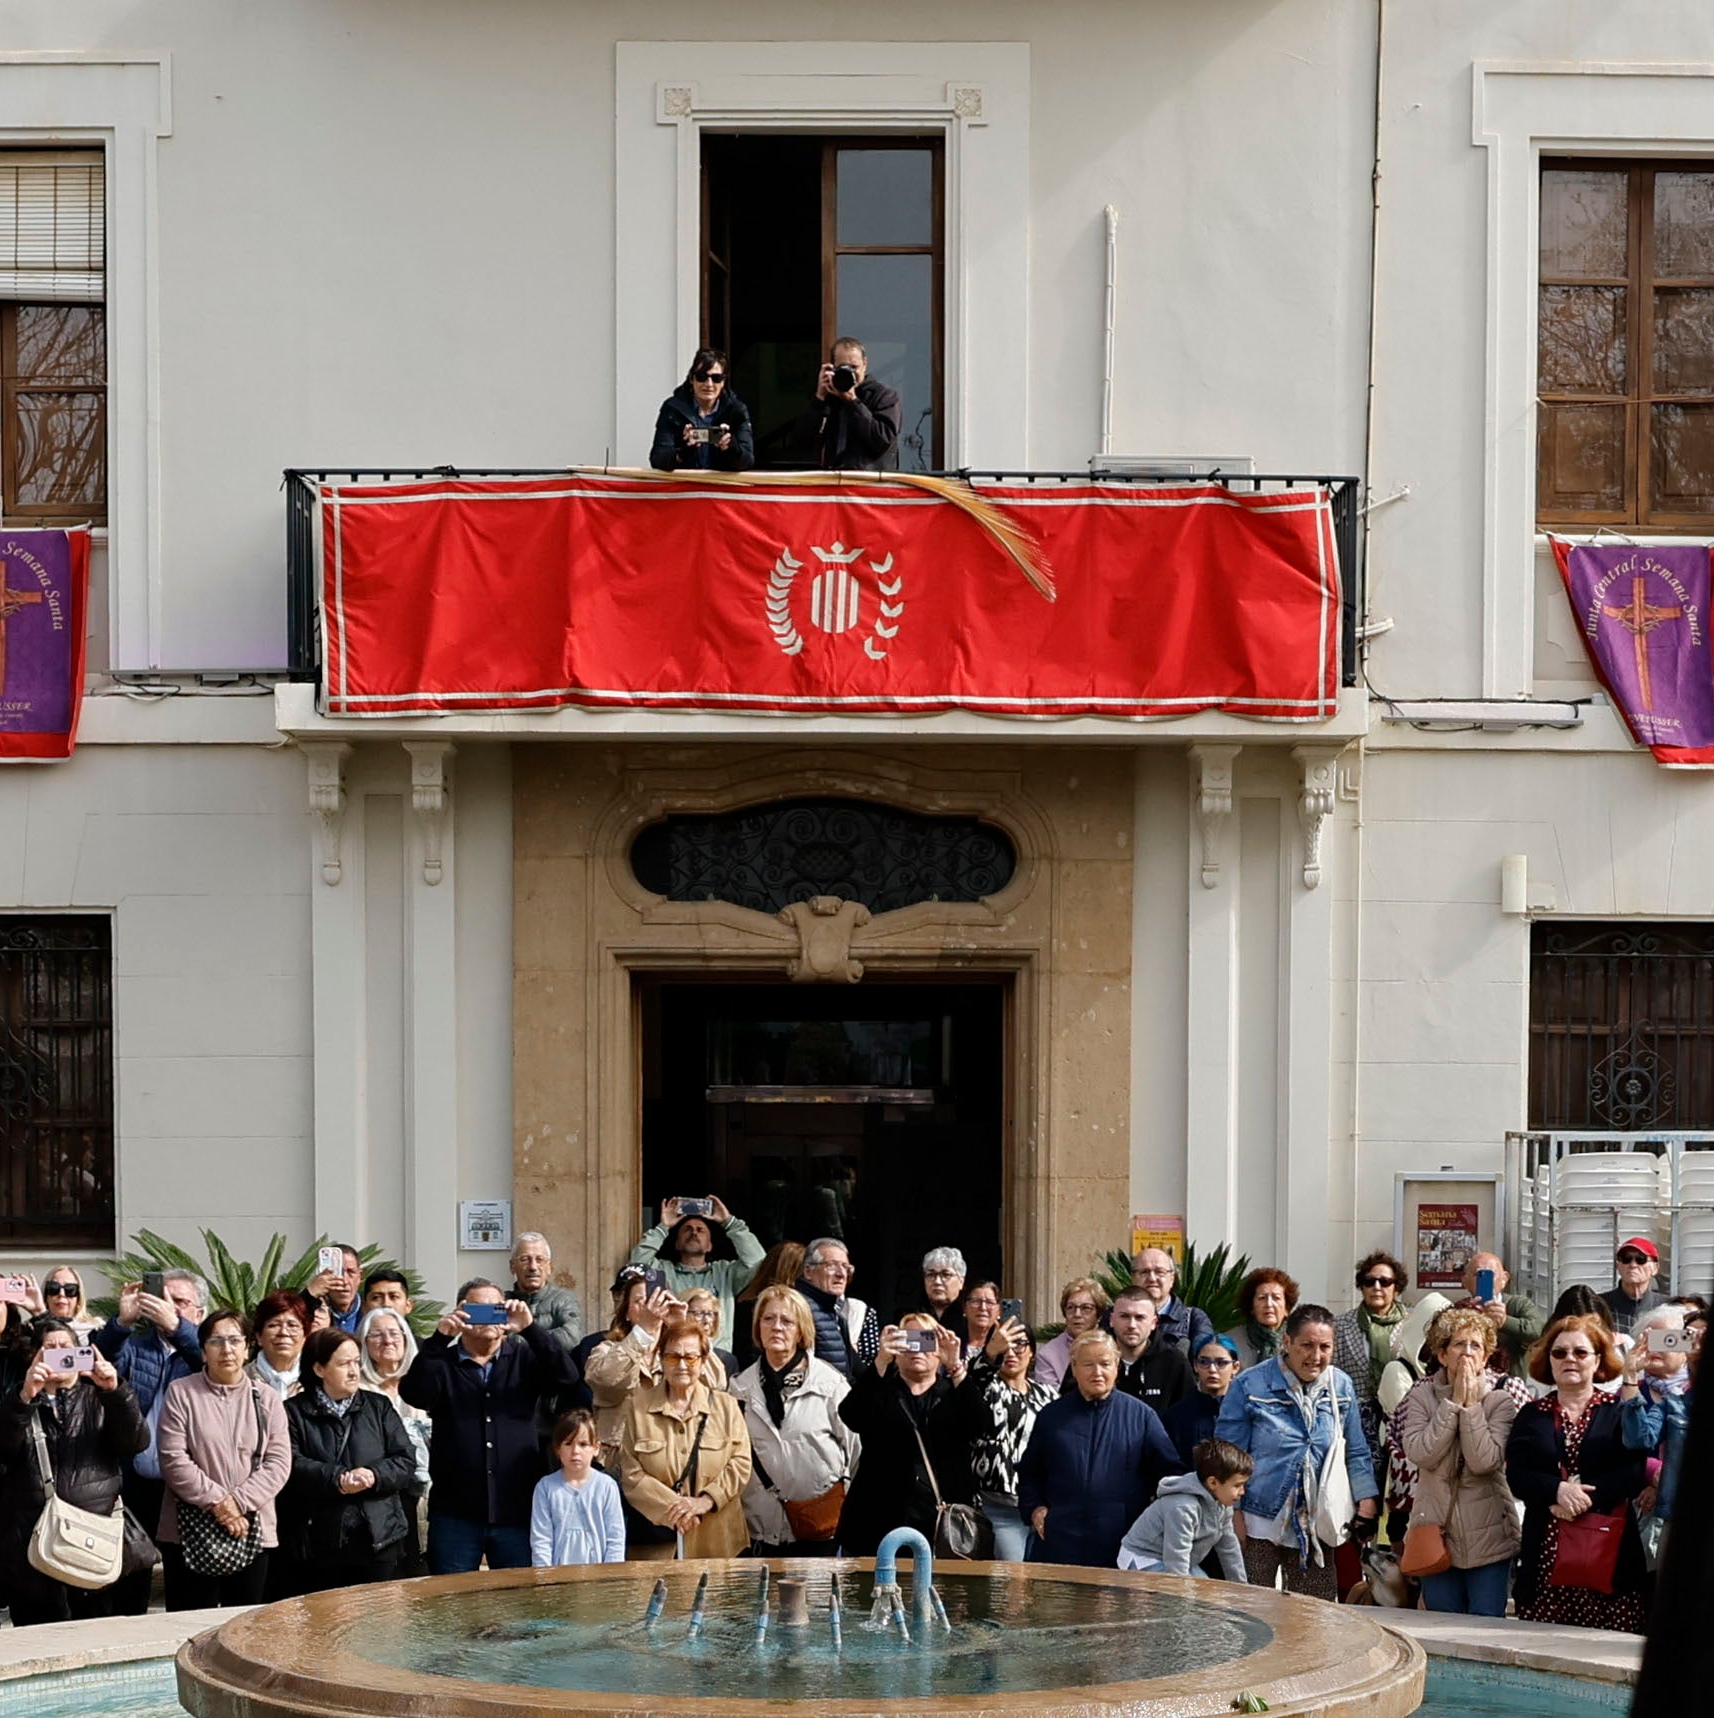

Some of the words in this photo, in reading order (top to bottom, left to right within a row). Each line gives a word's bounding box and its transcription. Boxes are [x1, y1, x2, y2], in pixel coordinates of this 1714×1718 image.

[2, 541, 51, 589] Semana
[45, 588, 63, 631] Santa
[1586, 600, 1602, 641] Junta
[1641, 557, 1689, 602] Semana
[1683, 604, 1702, 646] Santa
